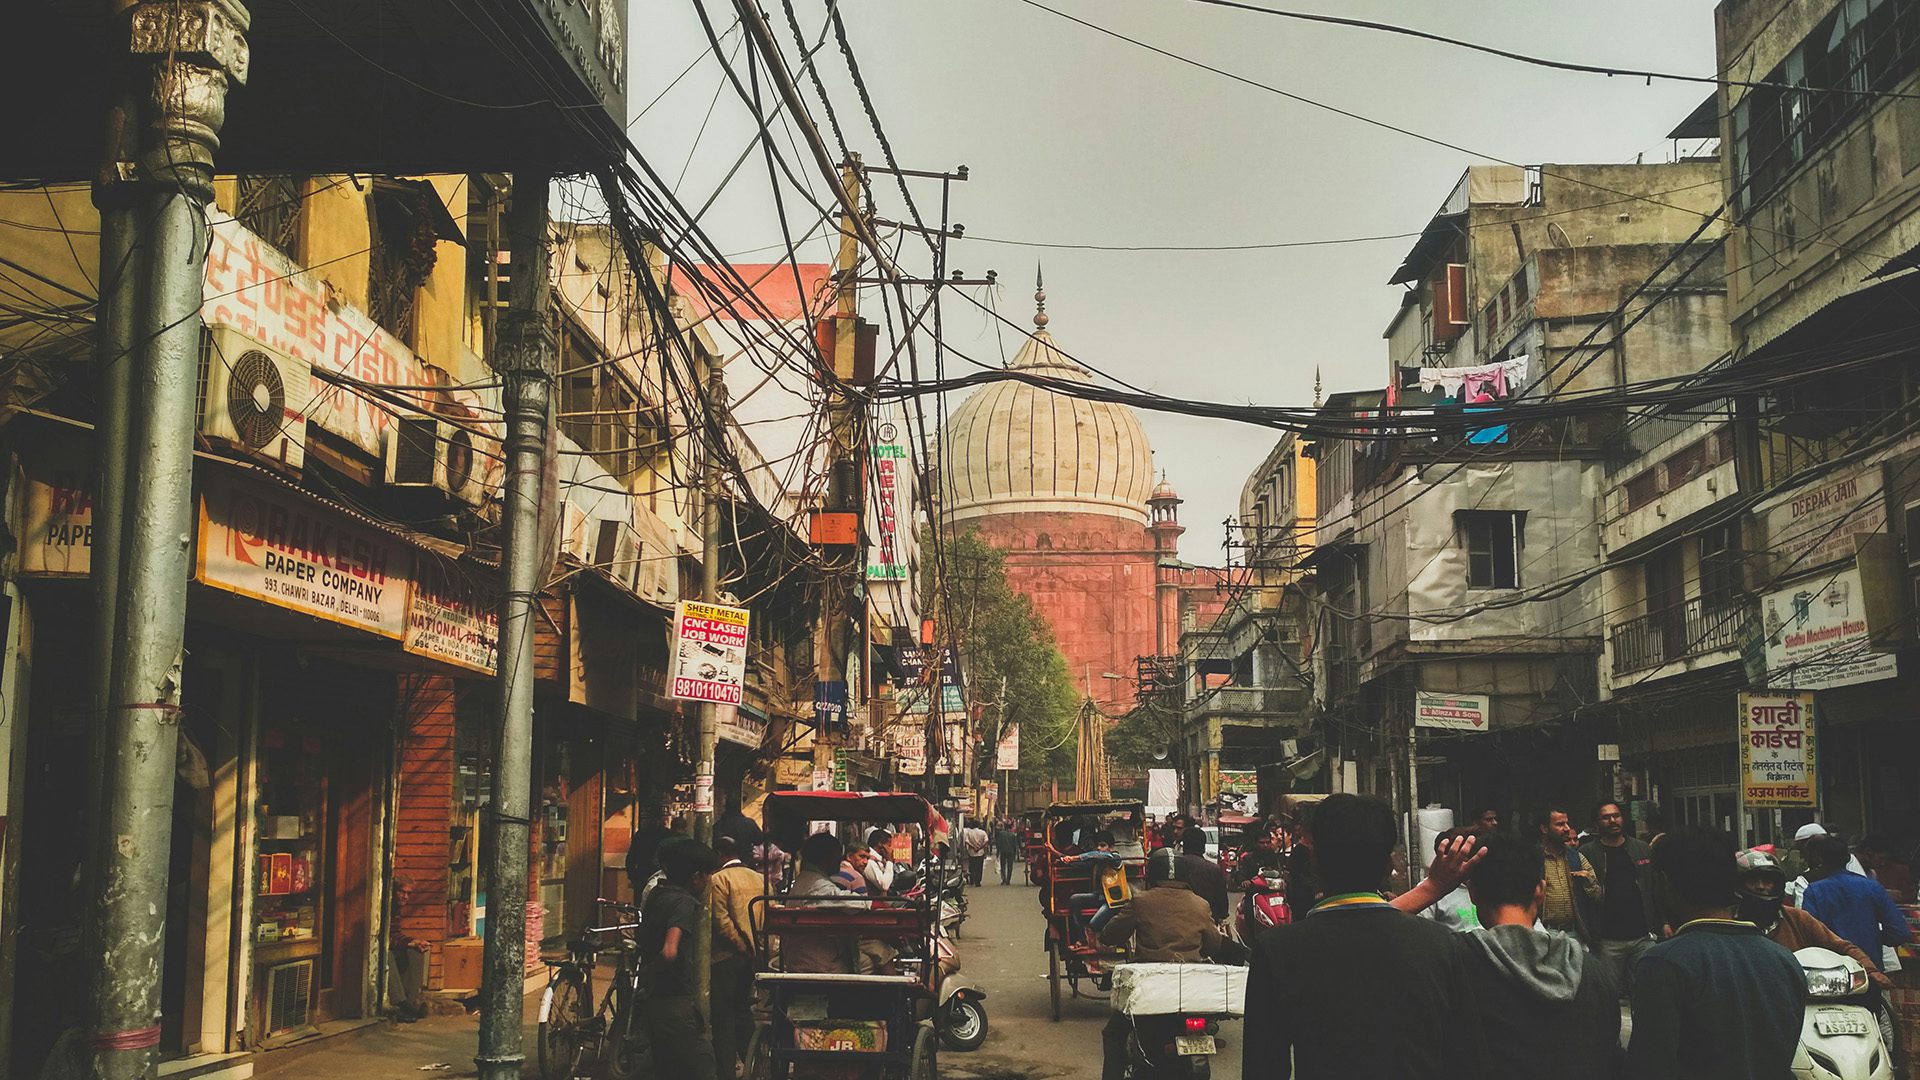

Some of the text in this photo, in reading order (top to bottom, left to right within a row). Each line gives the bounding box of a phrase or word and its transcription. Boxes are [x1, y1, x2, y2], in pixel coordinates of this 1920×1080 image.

[1792, 478, 1858, 518] DEEPAK JAIN
[266, 507, 389, 586] RAKESH
[265, 551, 316, 584] PAPER
[322, 570, 383, 605] COMPANY
[281, 584, 309, 601] CHAWRI
[687, 603, 745, 621] SHEET METAL
[410, 611, 461, 642] NATIONAL
[683, 629, 744, 647] JOB WORK
[684, 618, 745, 636] CNC LASER
[1806, 623, 1842, 645] Machinery
[1842, 619, 1866, 636] House
[433, 644, 462, 659] CHAWRI
[676, 678, 740, 703] 9810110476
[1751, 701, 1803, 725] शादी
[1747, 785, 1810, 798] अजय मार्किट
